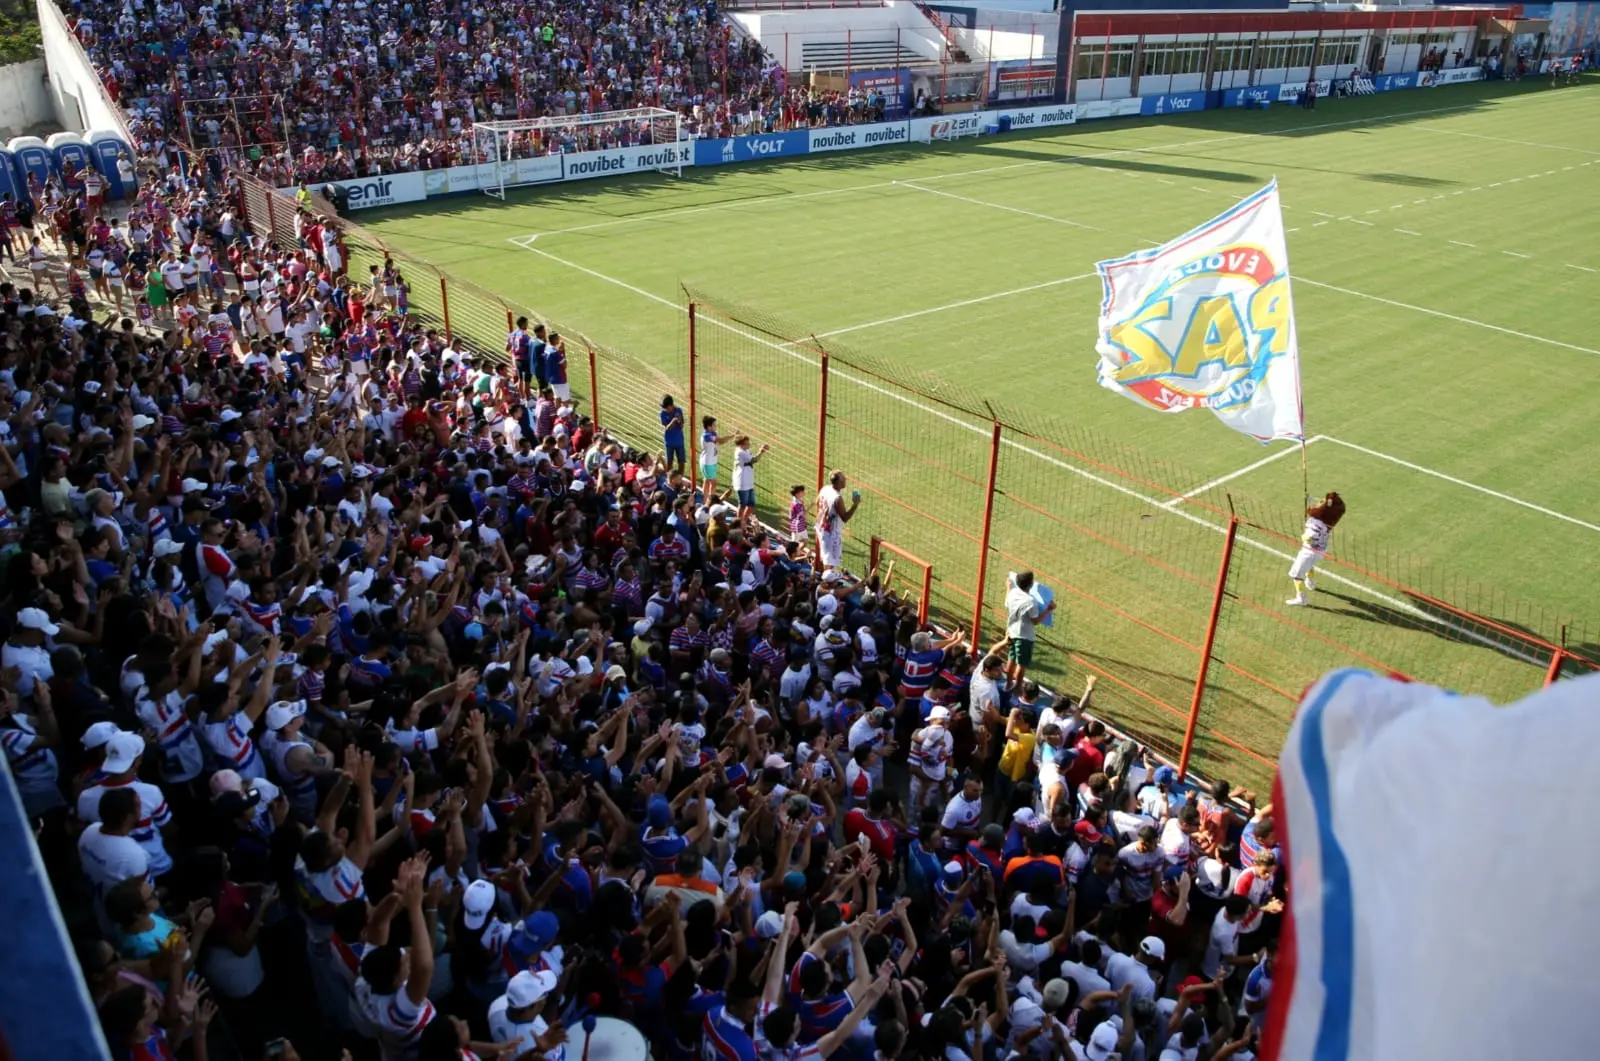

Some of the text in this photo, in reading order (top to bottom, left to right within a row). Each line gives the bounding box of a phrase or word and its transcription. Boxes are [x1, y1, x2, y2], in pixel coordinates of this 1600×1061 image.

[1012, 112, 1035, 125] vibet
[1041, 109, 1074, 123] novibet
[746, 139, 785, 156] VOLT
[813, 127, 906, 149] novibet novibet
[569, 155, 625, 175] novibet
[637, 147, 691, 167] novibet
[347, 177, 393, 201] enir
